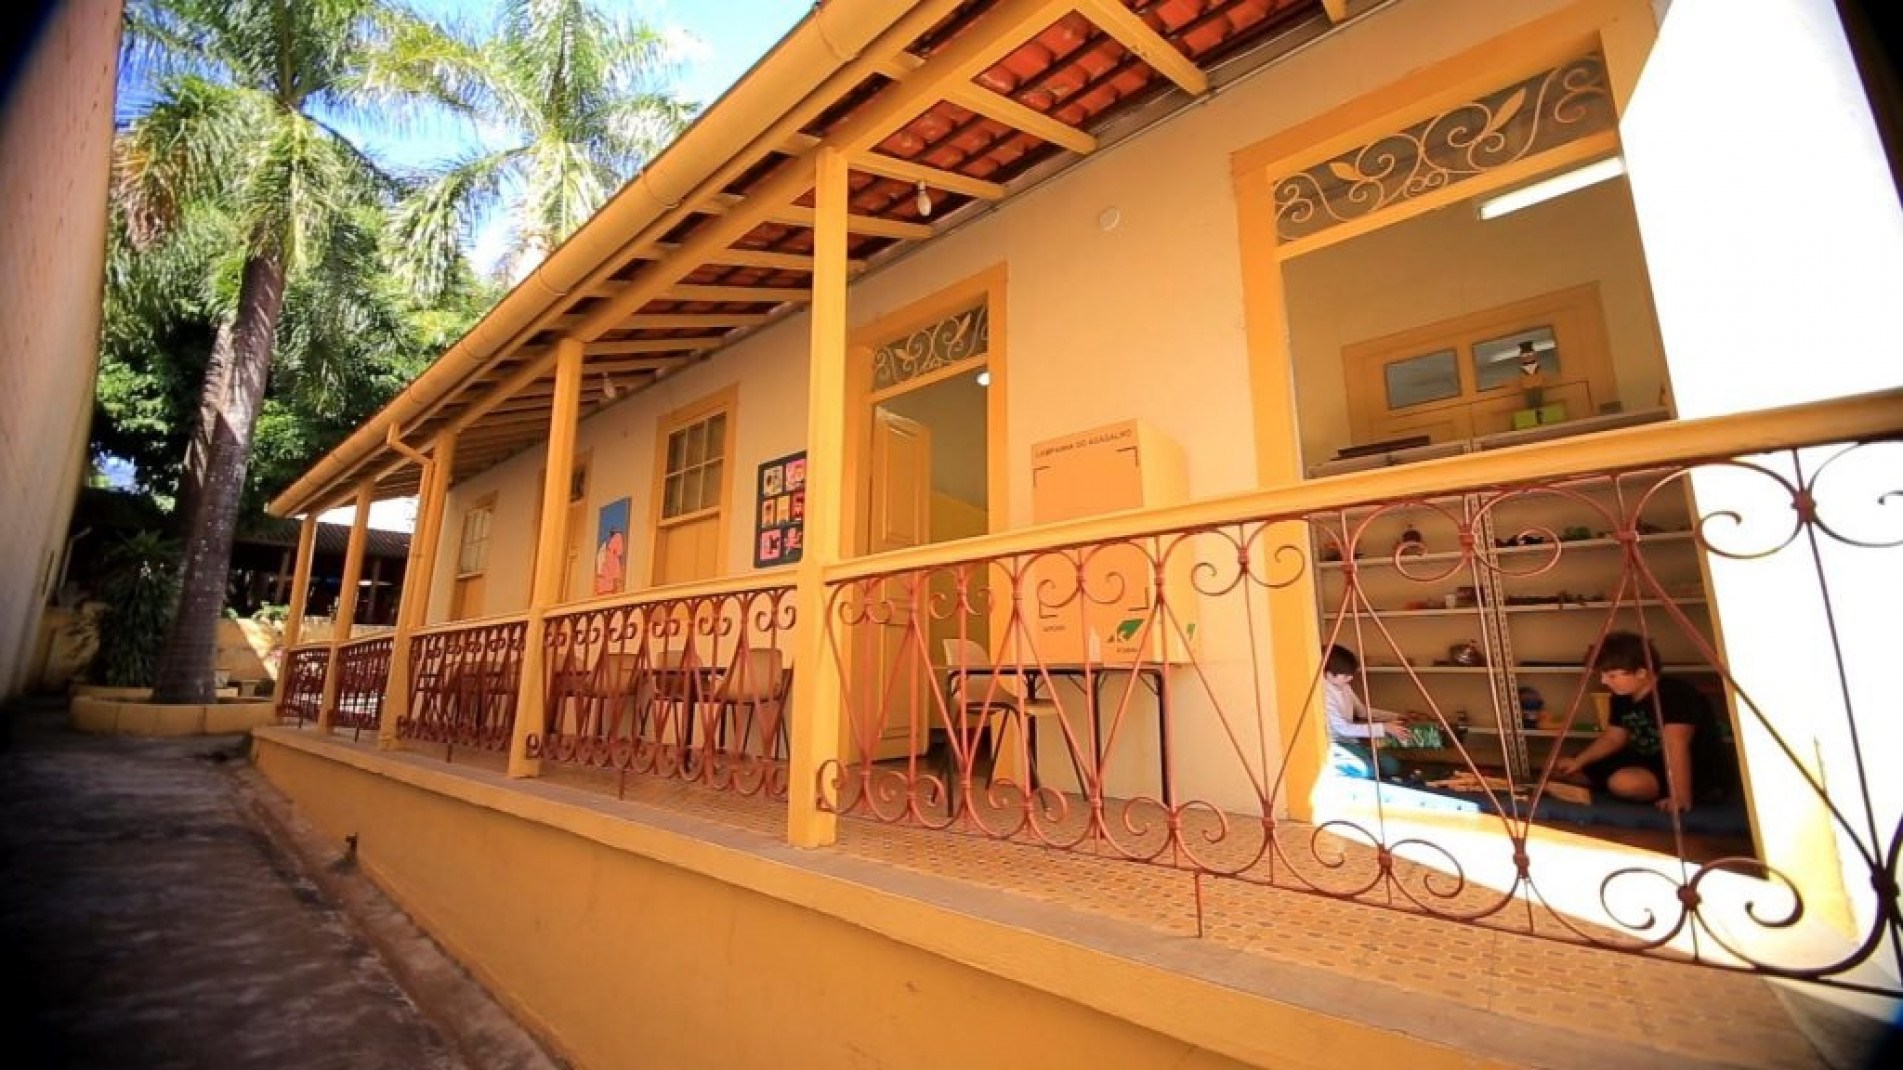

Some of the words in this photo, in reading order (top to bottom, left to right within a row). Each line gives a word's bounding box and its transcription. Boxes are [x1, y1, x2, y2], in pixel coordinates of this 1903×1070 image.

[1034, 443, 1074, 458] CAMPANHA
[1075, 439, 1088, 449] DO
[1088, 429, 1132, 446] AGASALHO
